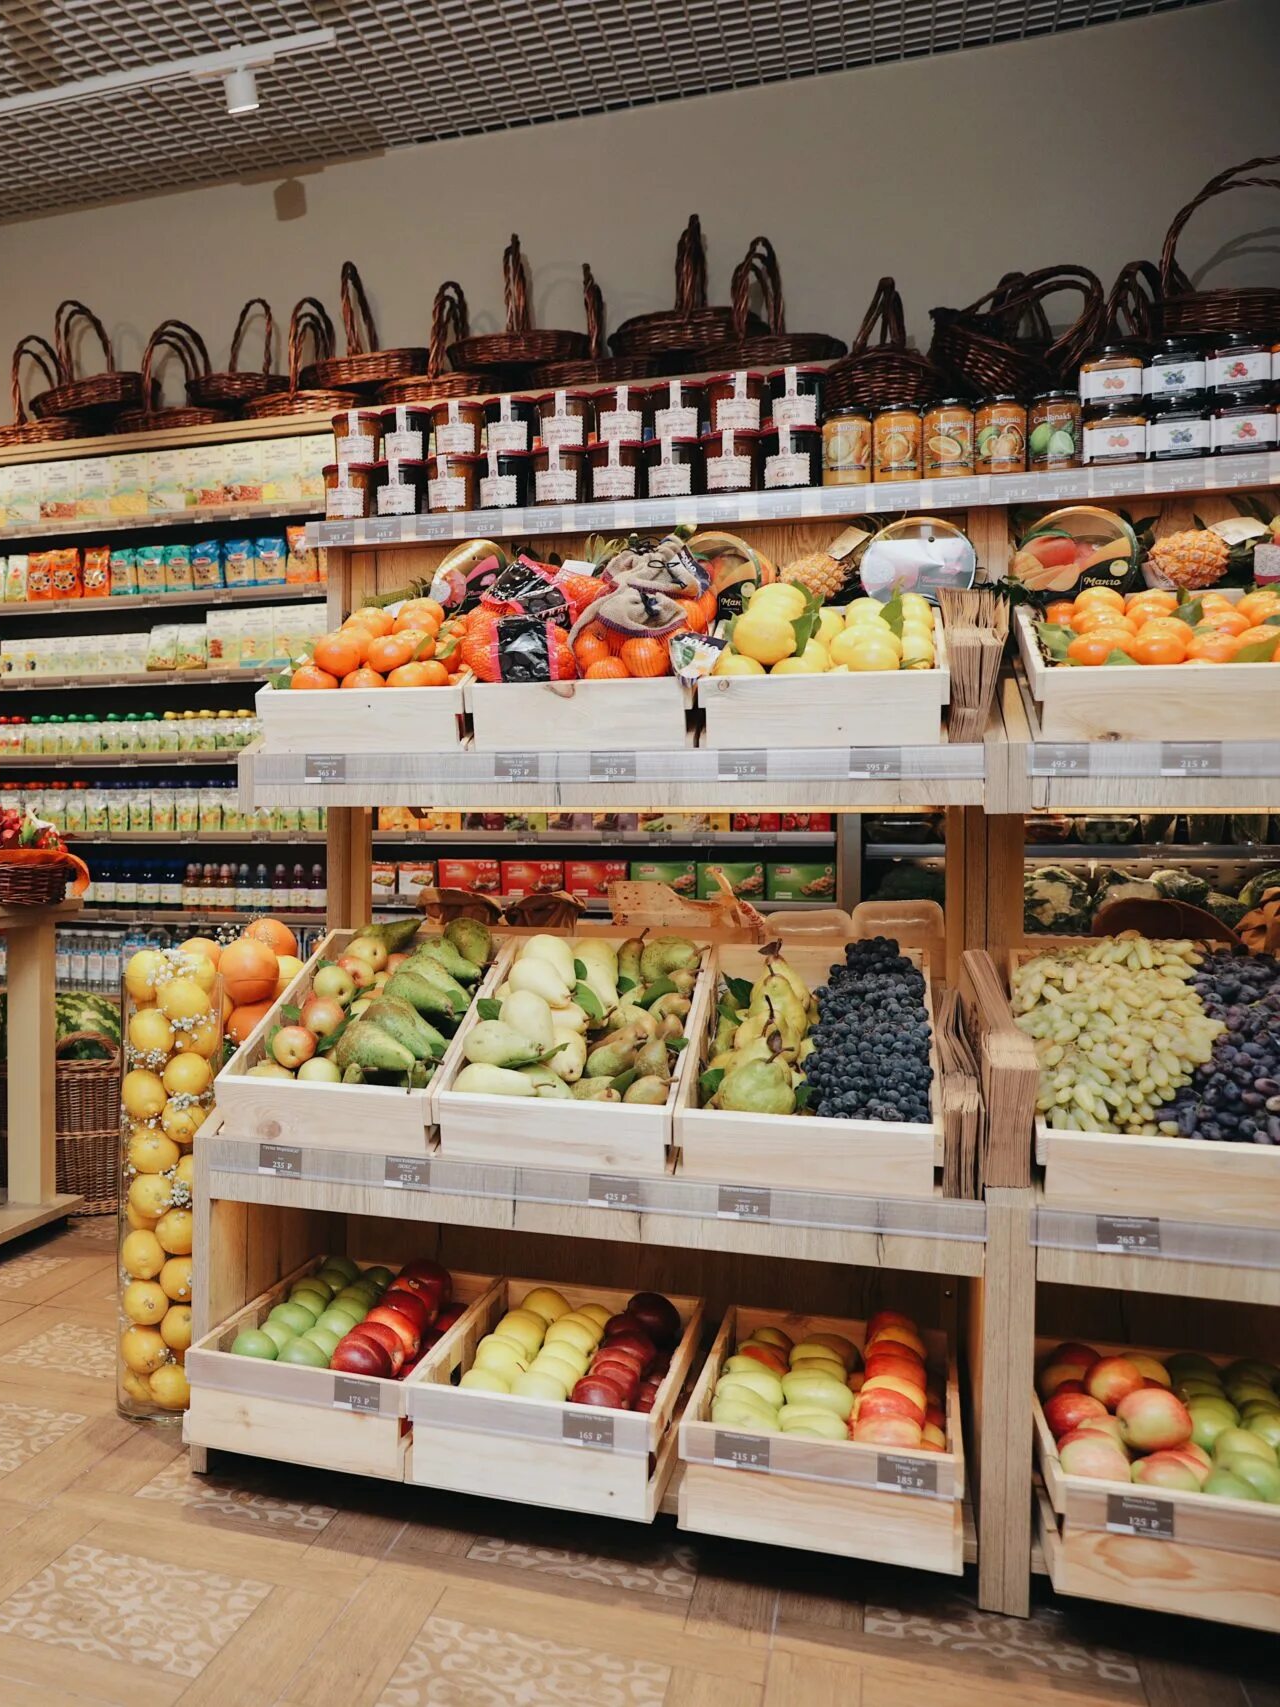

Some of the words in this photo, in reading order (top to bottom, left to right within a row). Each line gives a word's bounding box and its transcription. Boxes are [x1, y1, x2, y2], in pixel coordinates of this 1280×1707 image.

[1083, 576, 1121, 586] Манго
[1051, 760, 1066, 768] 495
[1180, 760, 1198, 768] 215
[508, 768, 521, 776] 395
[604, 767, 617, 775] 585
[733, 766, 747, 774] 315
[272, 1161, 285, 1169] 235
[399, 1174, 412, 1182] 425
[604, 1193, 618, 1201] 425
[734, 1204, 749, 1213] 285
[1117, 1236, 1135, 1245] 265
[348, 1395, 361, 1404] 175
[579, 1431, 593, 1440] 165
[731, 1451, 748, 1462] 215
[896, 1475, 913, 1486] 185
[1128, 1516, 1147, 1527] 125
